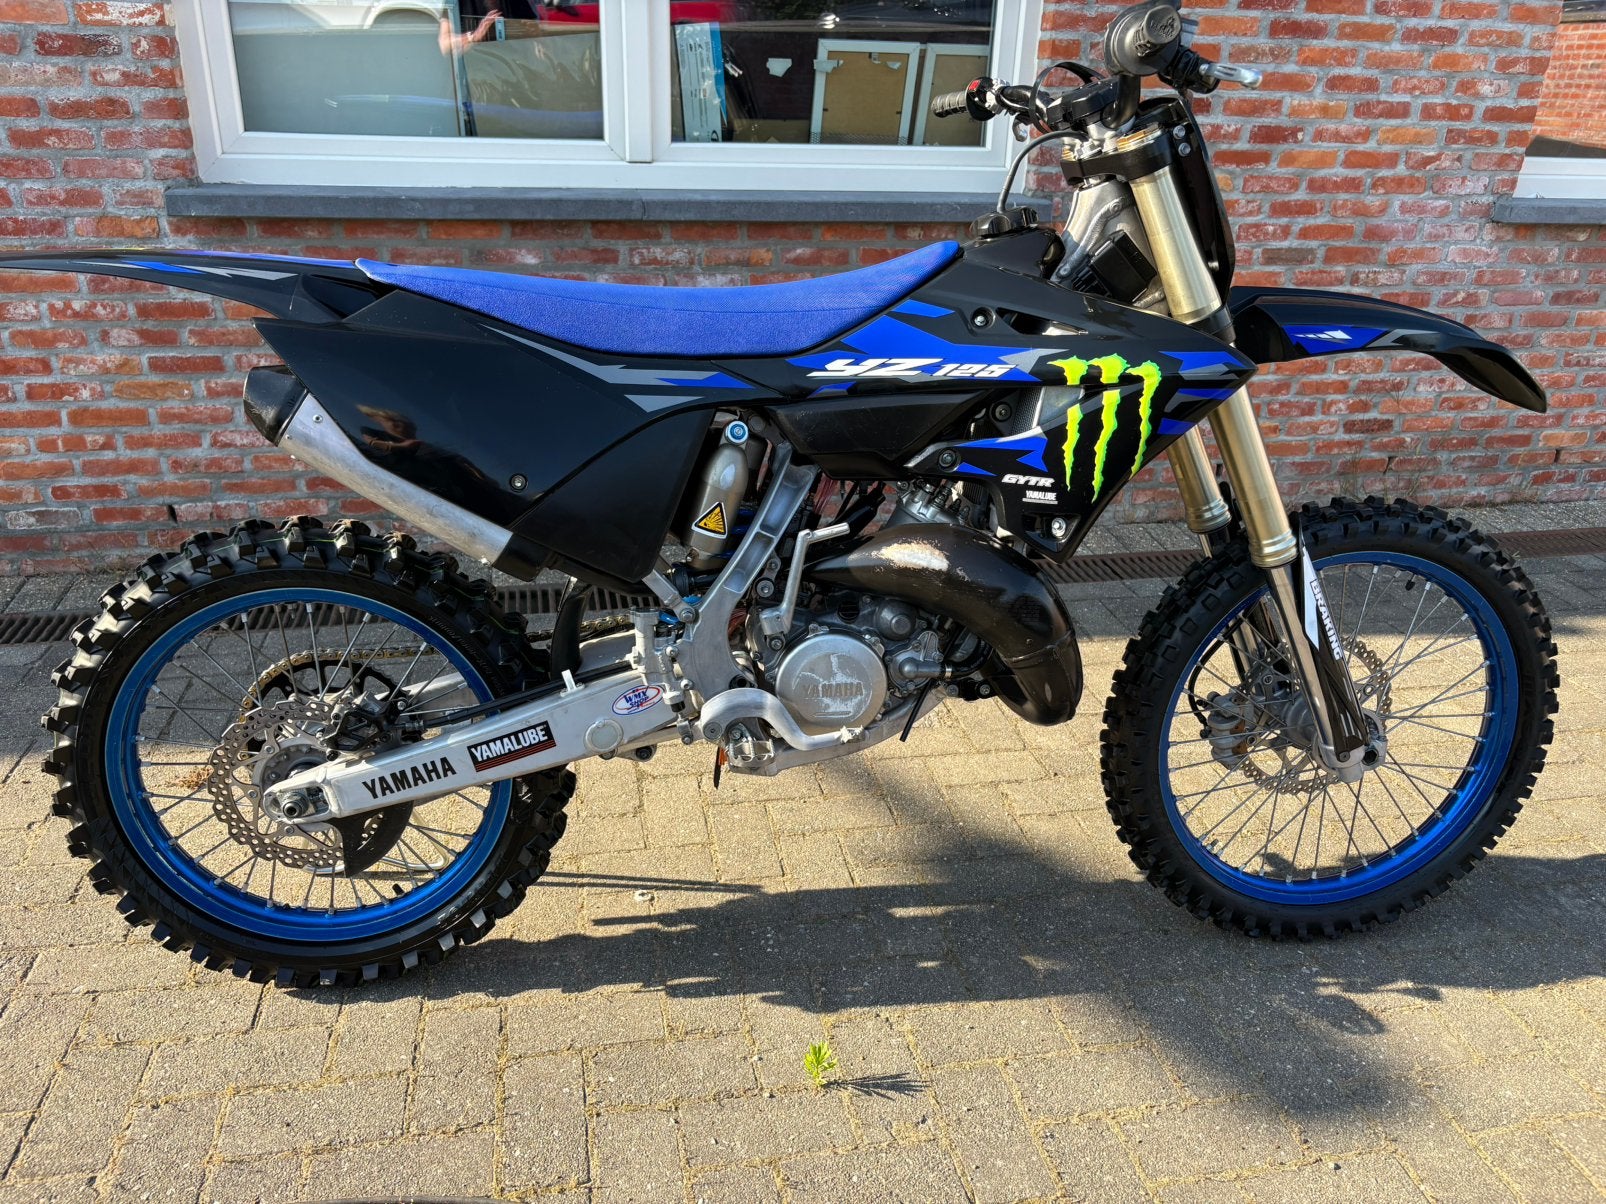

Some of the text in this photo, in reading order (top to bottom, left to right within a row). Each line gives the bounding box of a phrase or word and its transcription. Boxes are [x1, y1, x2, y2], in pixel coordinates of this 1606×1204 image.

[806, 357, 1018, 379] YZ 125
[1001, 473, 1056, 488] GYTR
[1025, 490, 1058, 501] YAMALUBE
[1310, 579, 1342, 661] BRAKING
[803, 682, 865, 698] YAMAHA
[470, 725, 548, 763] YAMALUBE
[362, 756, 457, 800] YAMAHA
